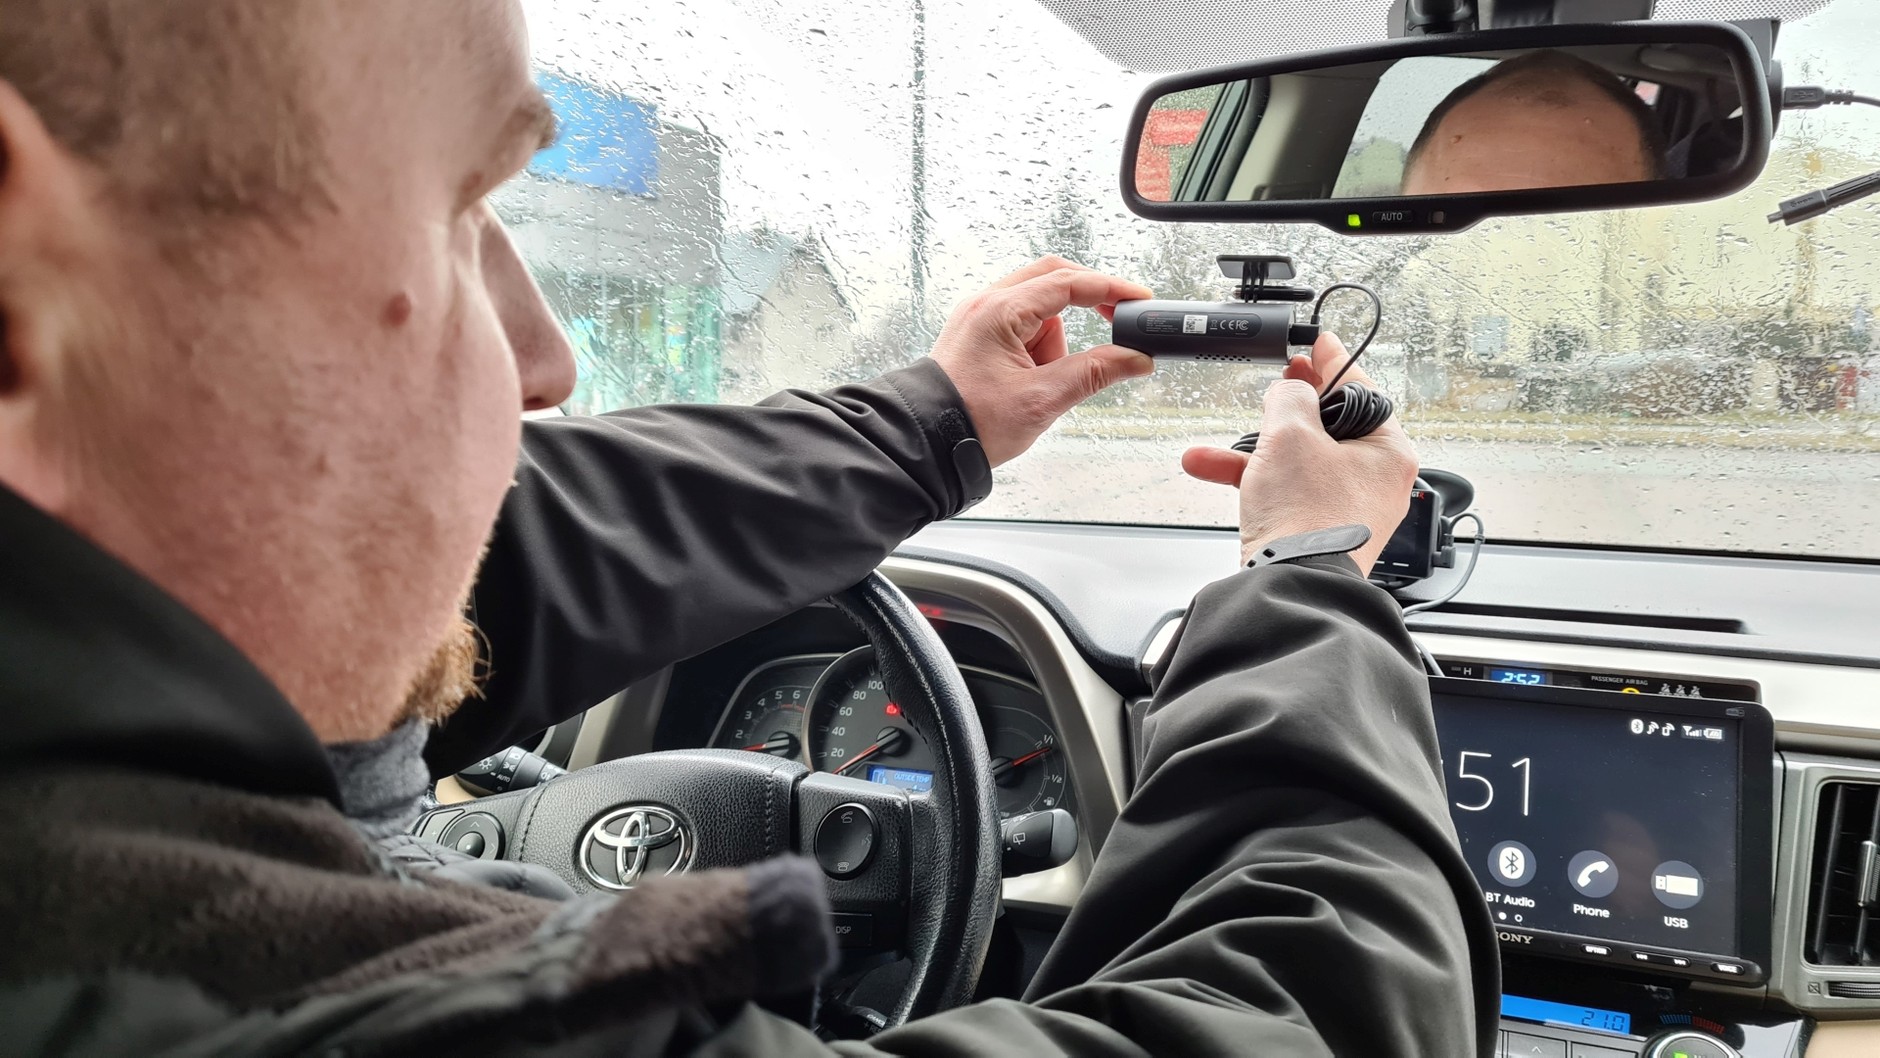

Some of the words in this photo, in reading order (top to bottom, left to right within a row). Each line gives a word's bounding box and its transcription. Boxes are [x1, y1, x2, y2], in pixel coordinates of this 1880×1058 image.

[1381, 212, 1403, 221] AUTO
[1591, 675, 1623, 684] PASSENGER
[868, 680, 884, 691] 100
[774, 691, 783, 700] 5
[792, 690, 801, 700] 6
[852, 691, 867, 701] 80
[757, 698, 766, 707] 4
[744, 711, 752, 720] 3
[839, 707, 853, 717] 60
[735, 730, 744, 739] 2
[831, 727, 846, 737] 40
[830, 748, 845, 758] 20
[496, 774, 511, 783] AUTO
[1485, 892, 1501, 904] BT
[1504, 894, 1536, 908] Audio
[1573, 903, 1610, 918] Phone
[1664, 916, 1689, 929] USB
[835, 926, 852, 935] DISP
[1581, 1010, 1626, 1032] 21.0
